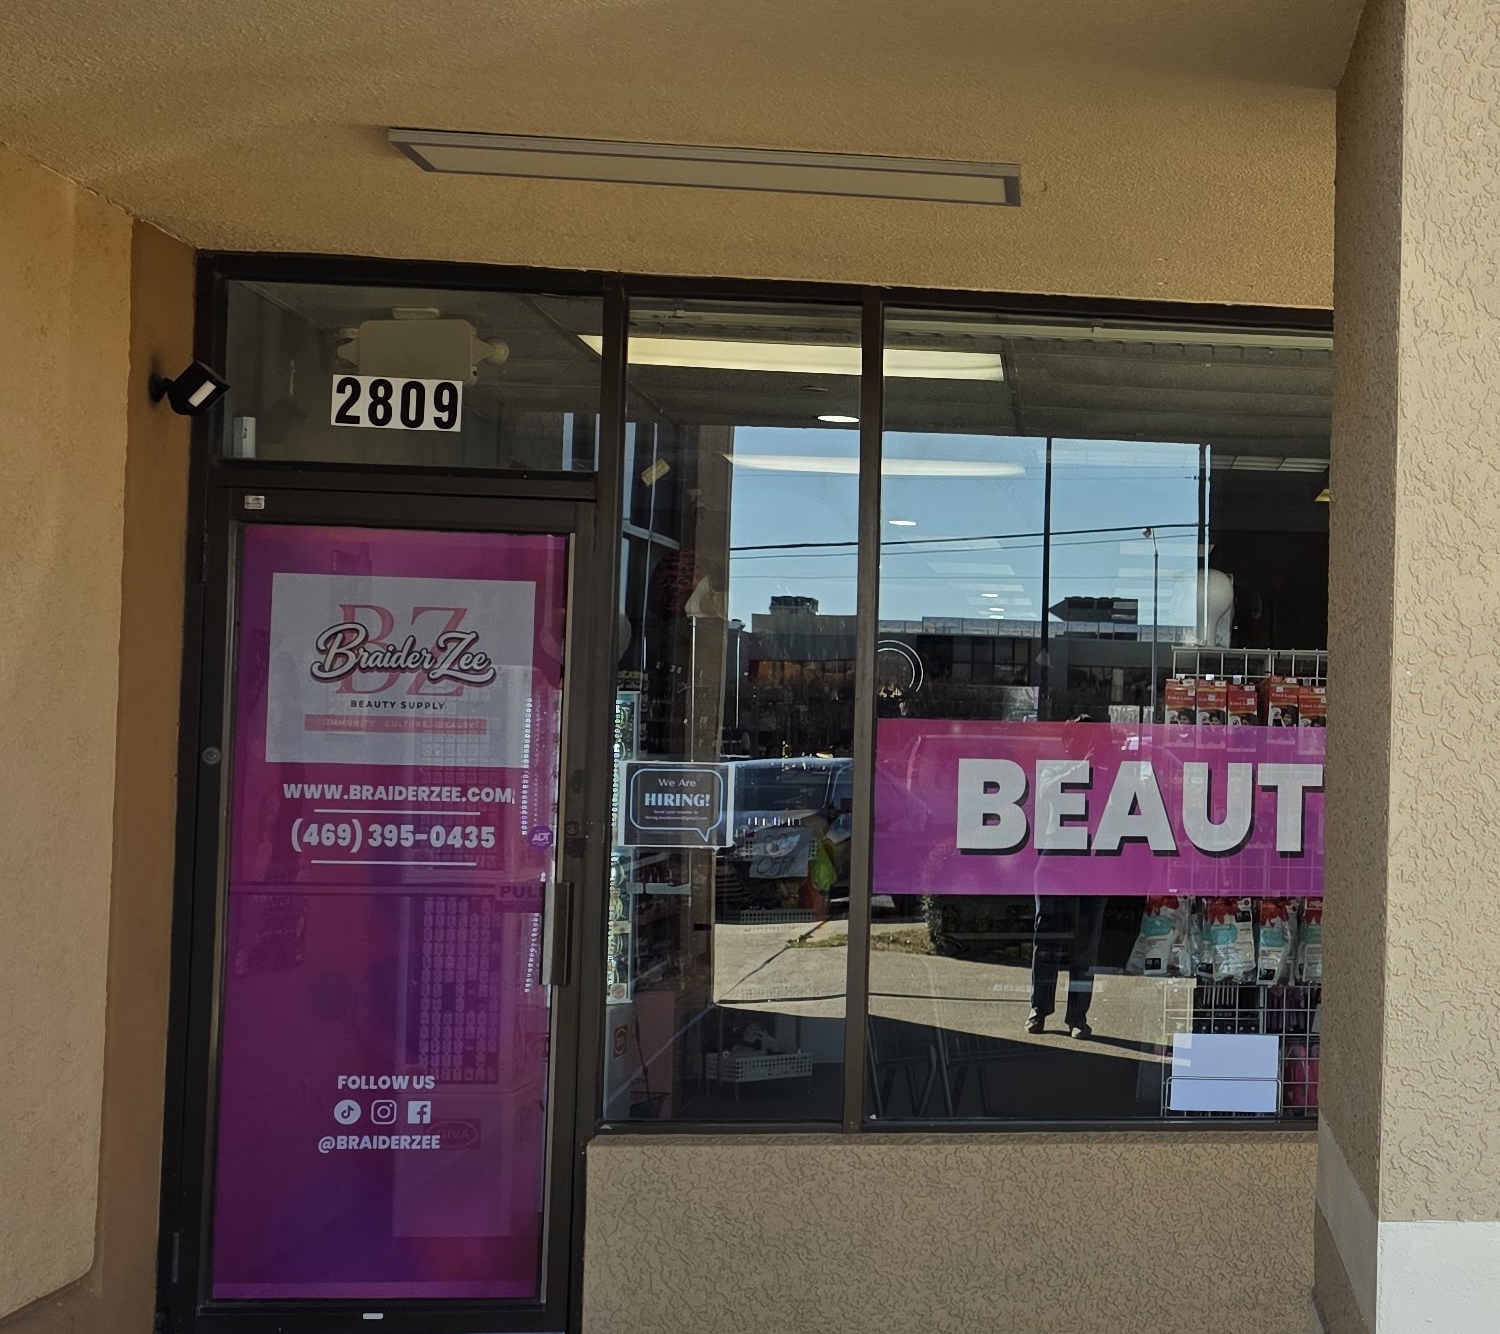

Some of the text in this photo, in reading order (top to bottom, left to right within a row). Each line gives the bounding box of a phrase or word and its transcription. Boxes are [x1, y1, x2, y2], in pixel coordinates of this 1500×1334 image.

[335, 376, 459, 429] 2809
[350, 699, 445, 710] BEAUTY SUPPLY
[657, 778, 697, 787] We Are
[283, 783, 512, 804] WWW.BRAIDERZEE.COM
[644, 793, 711, 807] HIRING!
[956, 758, 1324, 856] BEAUT
[291, 818, 496, 853] (469) 395-0435
[531, 832, 551, 842] ADT
[500, 885, 538, 898] PUL
[337, 1075, 435, 1090] FOLLOW US
[317, 1135, 441, 1154] @BRAIDERZEE
